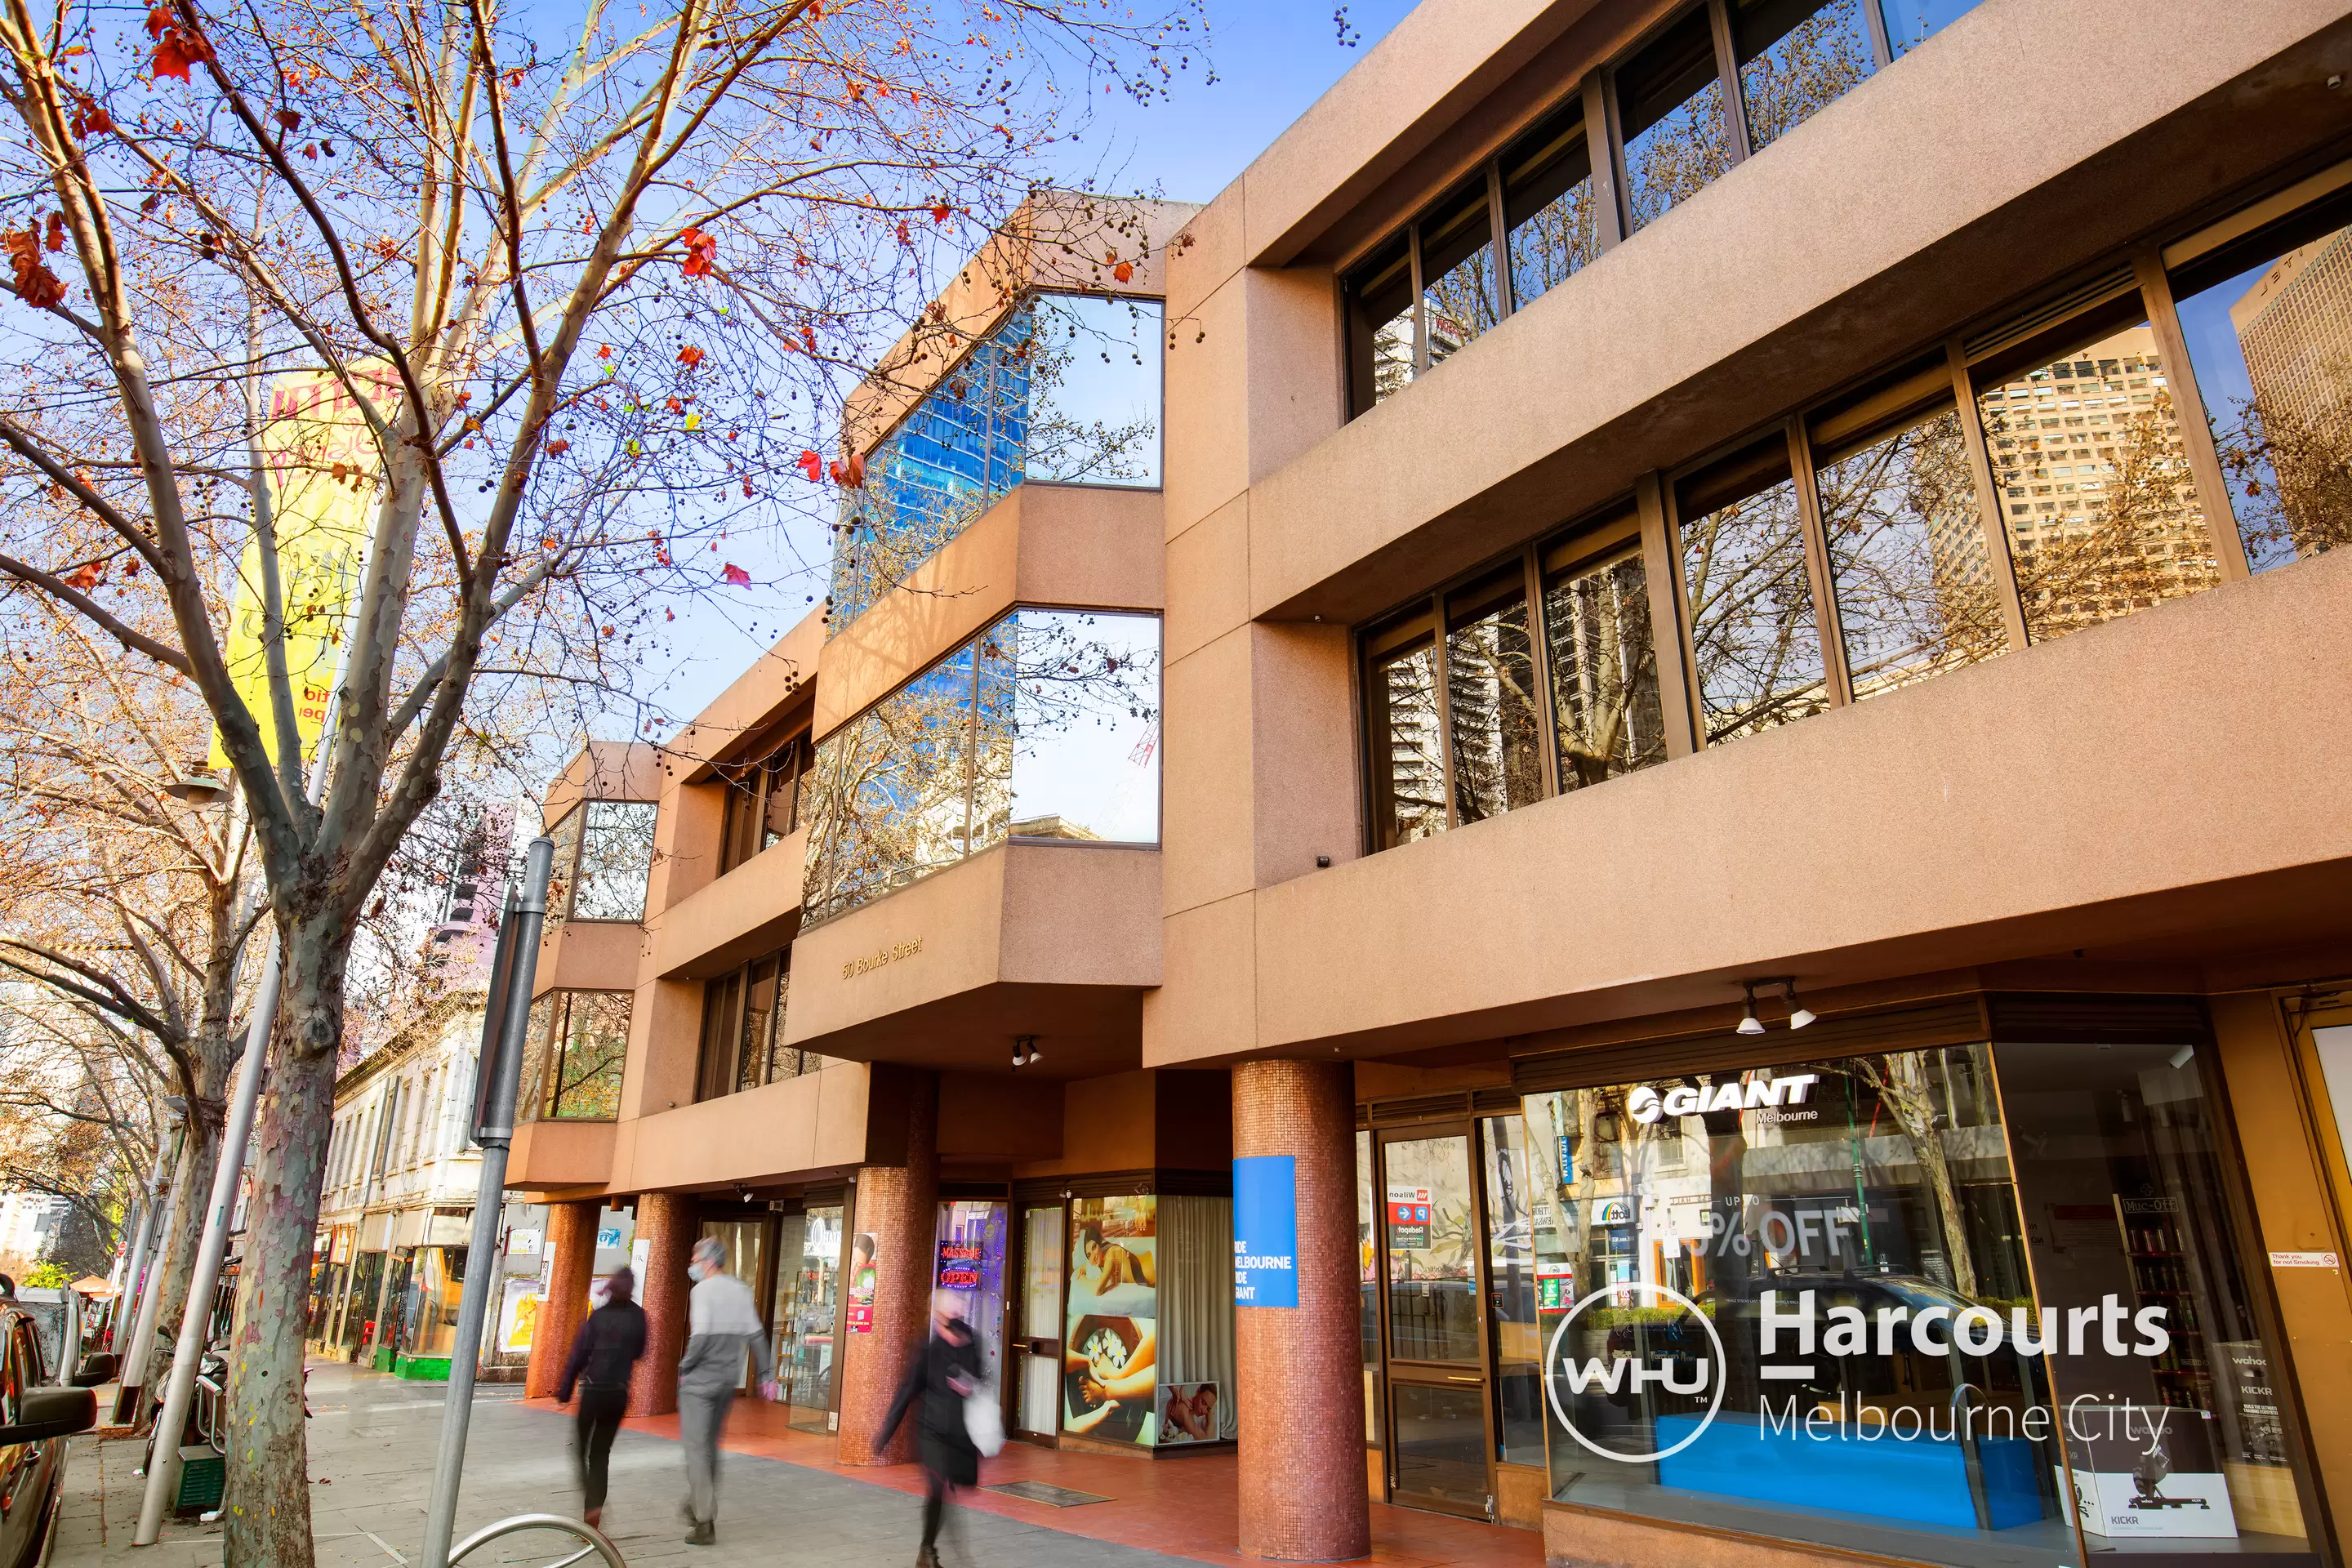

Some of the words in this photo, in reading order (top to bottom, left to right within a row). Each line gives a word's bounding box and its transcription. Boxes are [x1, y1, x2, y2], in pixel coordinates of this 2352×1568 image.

[842, 960, 855, 979] 50
[857, 950, 889, 974] Bourke
[892, 934, 922, 961] Street
[1664, 1074, 1820, 1116] GIANT
[1756, 1111, 1819, 1125] Melbourne
[1726, 1196, 1740, 1207] UP
[2126, 1200, 2177, 1212] Muc-Off
[1760, 1209, 1851, 1258] OFF
[942, 1247, 980, 1259] MASSAGE
[940, 1272, 979, 1285] OPEN
[2240, 1386, 2274, 1396] KICKR
[2111, 1516, 2139, 1525] KICKR
